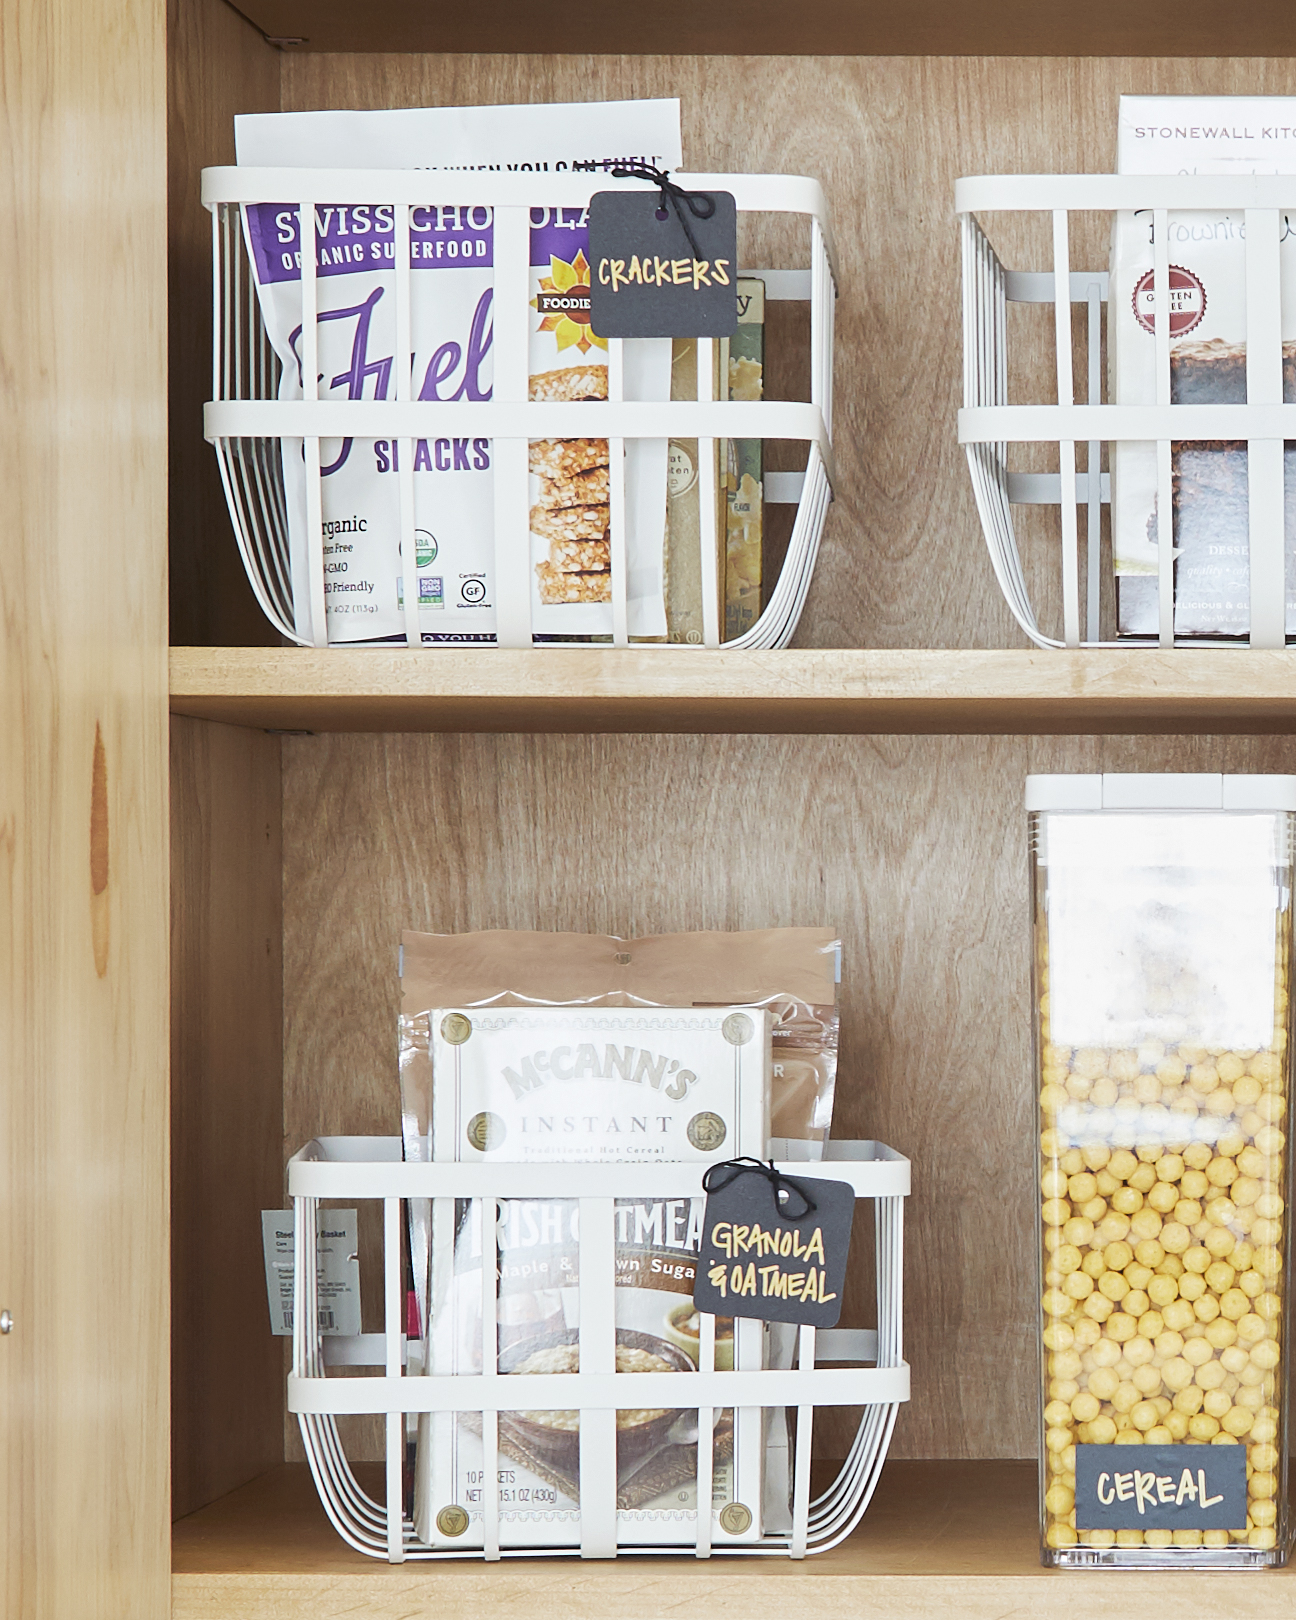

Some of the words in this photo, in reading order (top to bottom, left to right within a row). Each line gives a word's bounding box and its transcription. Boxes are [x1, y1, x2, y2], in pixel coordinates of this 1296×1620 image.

[1134, 126, 1255, 139] STONEWALL
[598, 254, 730, 293] CRACKERS
[334, 581, 375, 595] Friendly
[466, 587, 480, 596] GF
[521, 1116, 675, 1134] INSTANT
[711, 1221, 825, 1265] GRANOLA
[560, 1257, 573, 1270] &
[465, 1471, 477, 1484] 10
[465, 1489, 483, 1501] NET
[519, 1489, 530, 1501] OZ
[532, 1487, 557, 1504] (430g)
[1096, 1467, 1224, 1514] CEREAL
